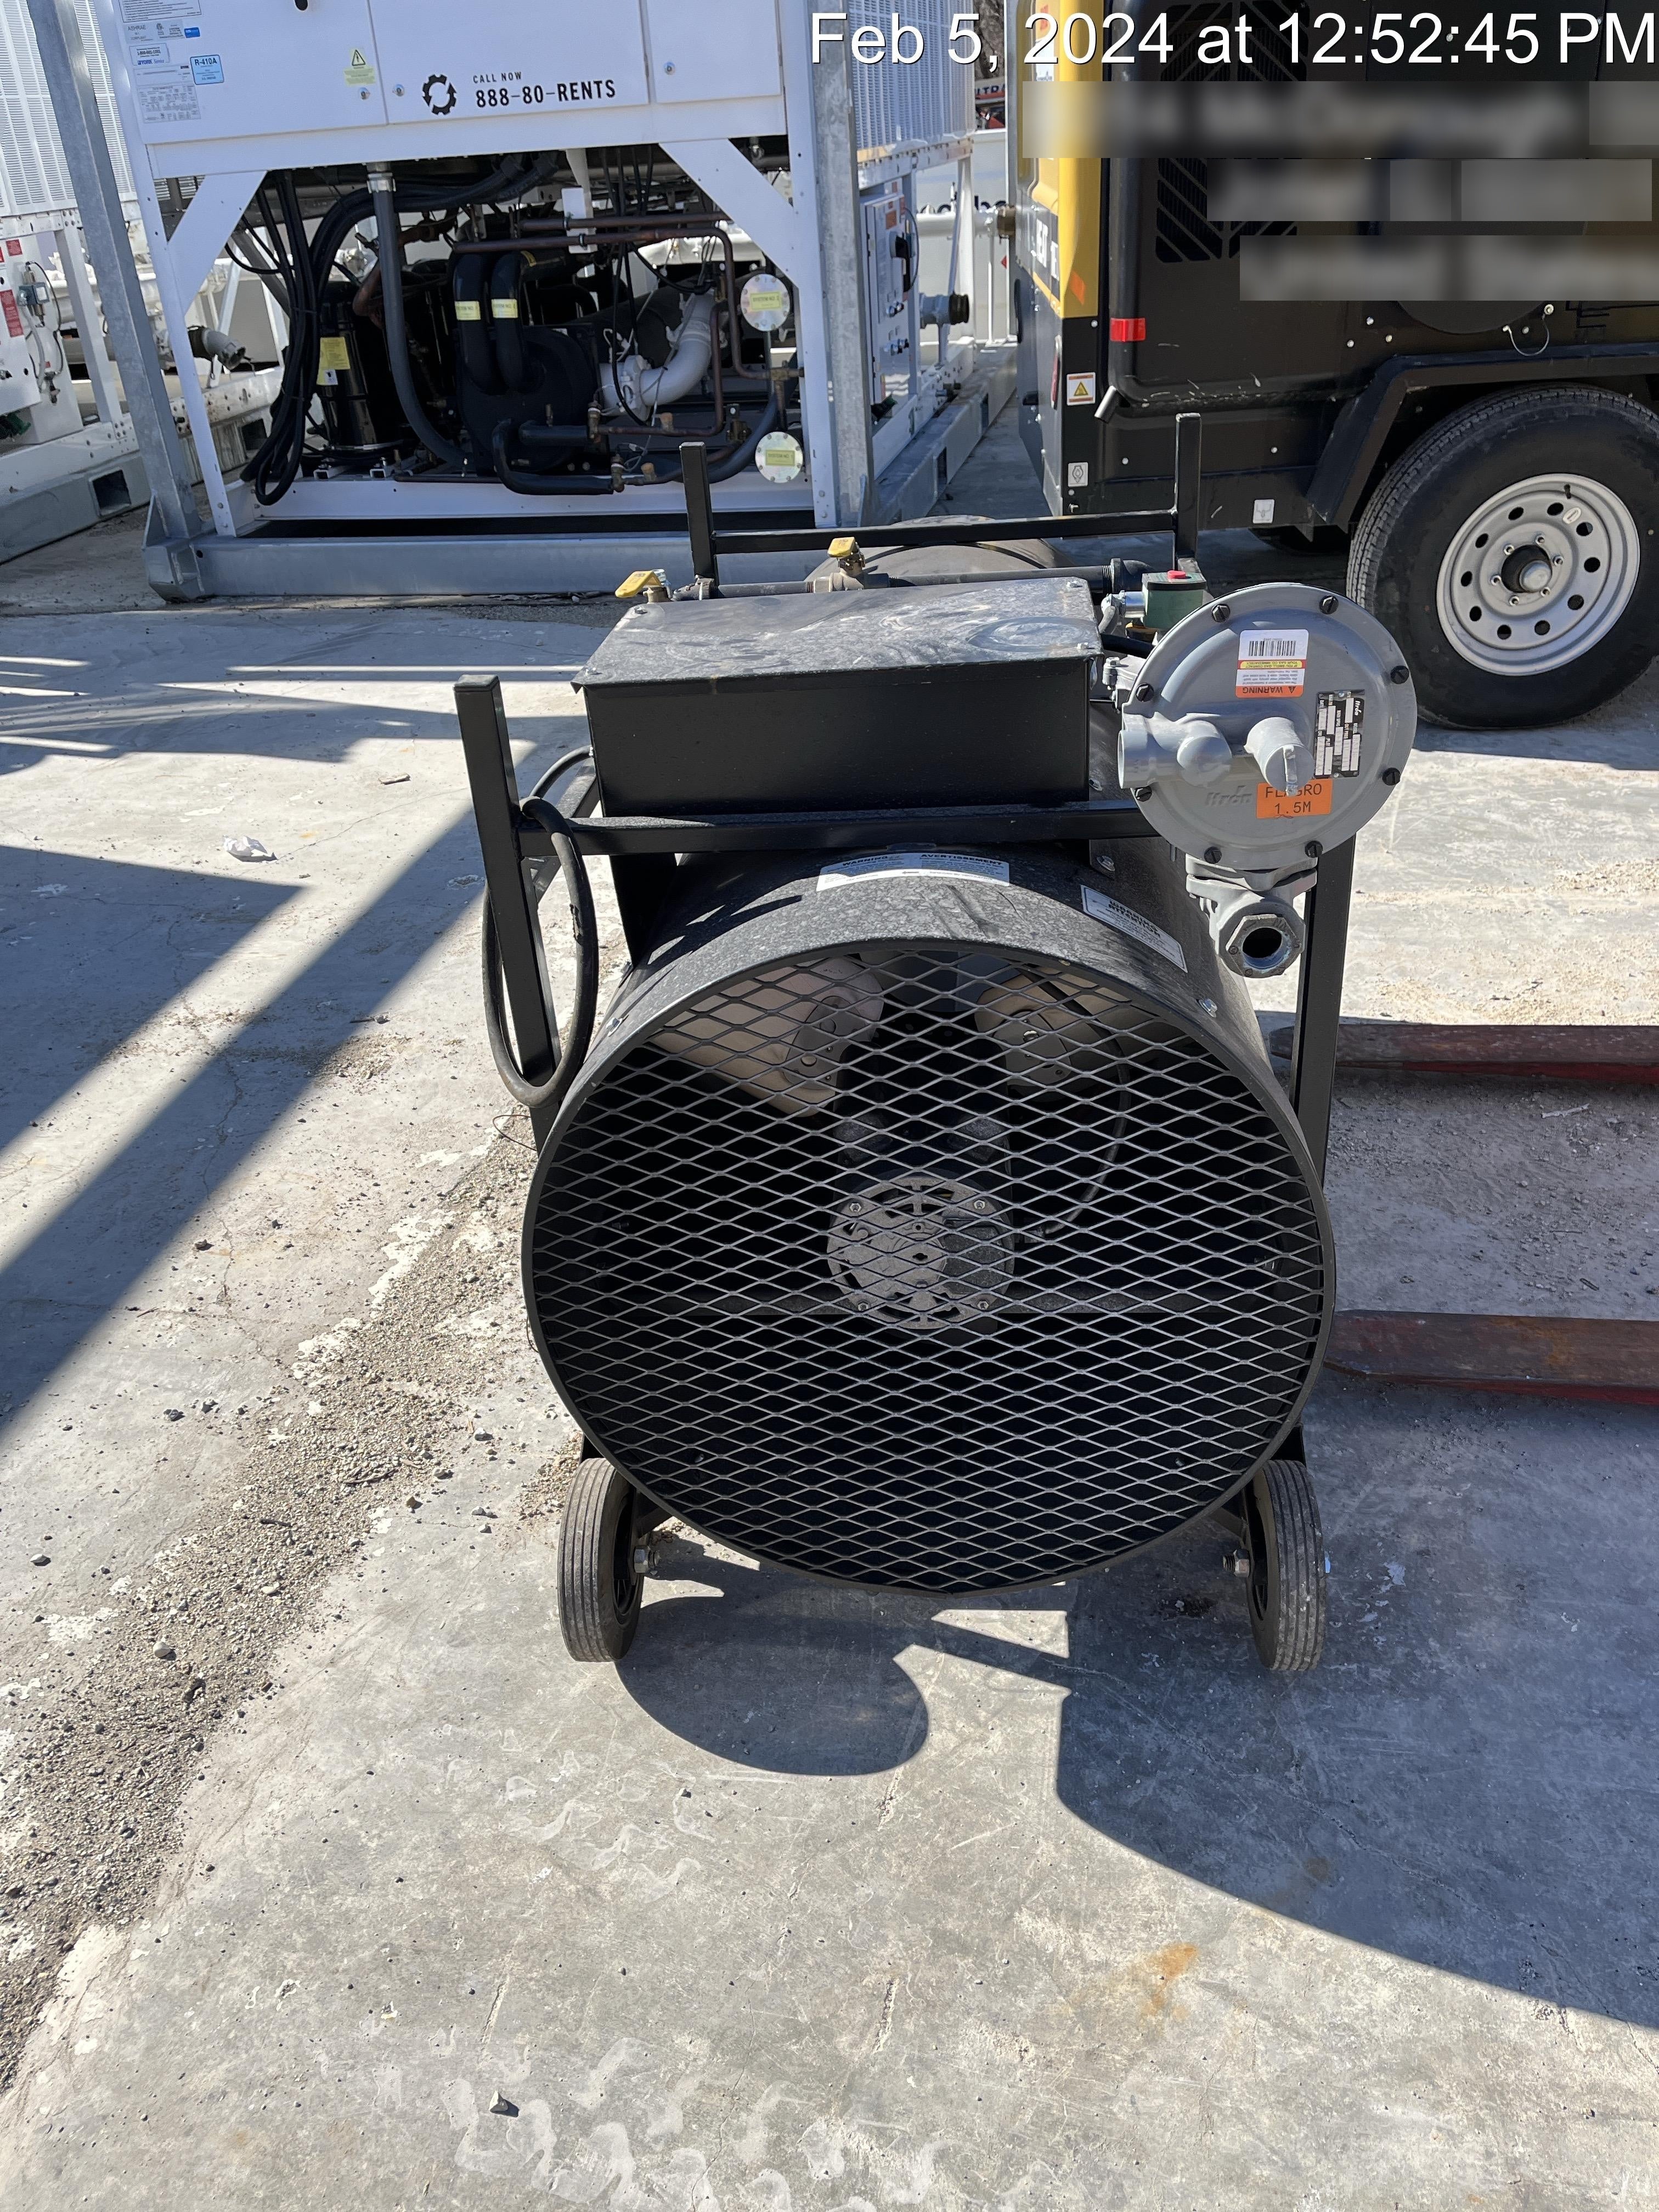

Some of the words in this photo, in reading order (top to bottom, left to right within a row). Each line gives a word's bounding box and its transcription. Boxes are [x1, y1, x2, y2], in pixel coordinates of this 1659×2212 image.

[195, 58, 217, 66] R-410A
[472, 73, 497, 84] CALL
[501, 71, 522, 81] NOW
[475, 79, 616, 108] 888-80-RENTS
[1265, 783, 1322, 798] FLGRO
[842, 855, 888, 866] WARNING
[921, 854, 1002, 865] AVERTISSEMENT
[1109, 900, 1159, 932] WARNING
